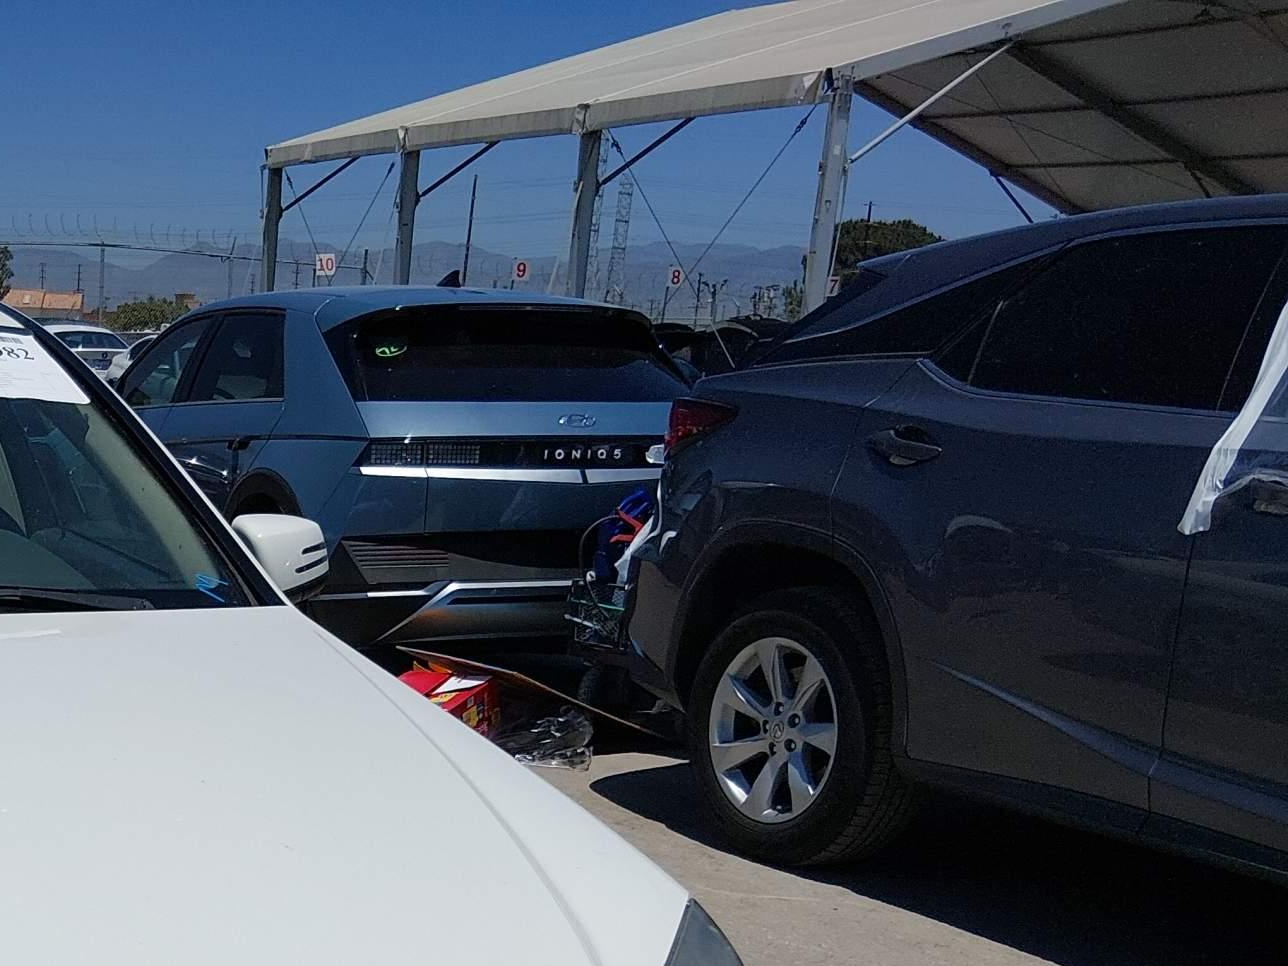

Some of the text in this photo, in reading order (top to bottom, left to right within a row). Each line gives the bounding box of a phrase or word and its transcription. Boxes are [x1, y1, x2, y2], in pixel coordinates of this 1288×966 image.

[317, 257, 334, 272] 10
[516, 262, 527, 278] 9
[671, 269, 681, 285] 8
[829, 279, 839, 294] 7
